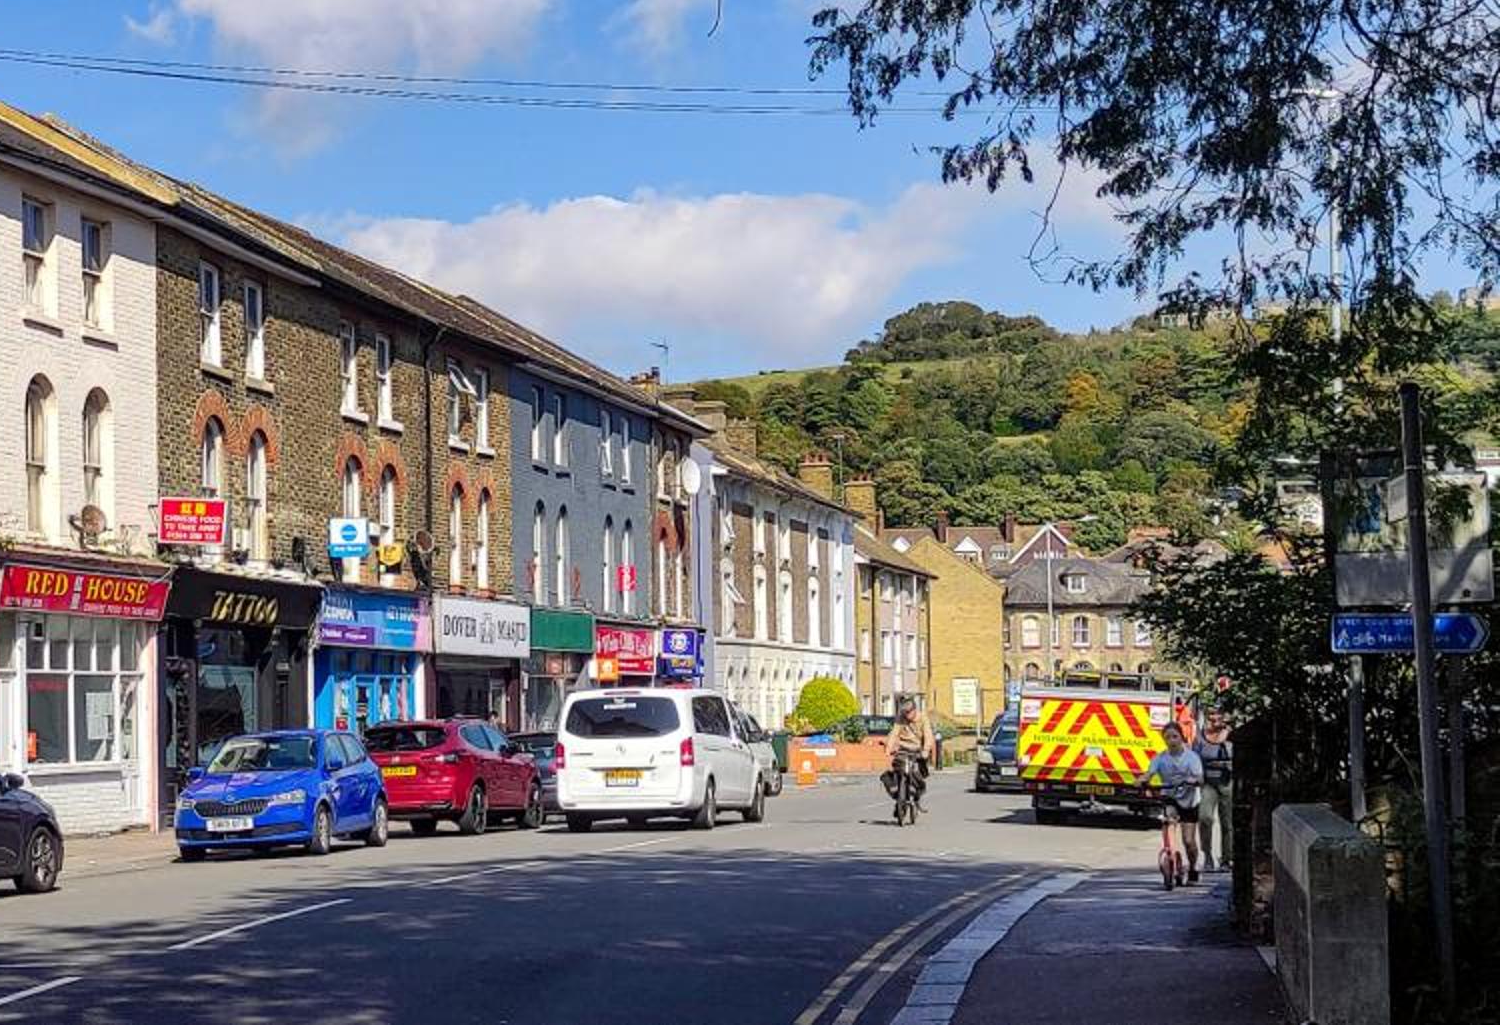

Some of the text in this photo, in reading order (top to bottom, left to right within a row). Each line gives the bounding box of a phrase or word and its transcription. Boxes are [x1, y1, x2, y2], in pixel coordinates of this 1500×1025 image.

[25, 570, 69, 596] RED
[86, 577, 149, 605] HOUSE
[211, 590, 279, 624] TATTOO
[443, 614, 477, 638] DOVER
